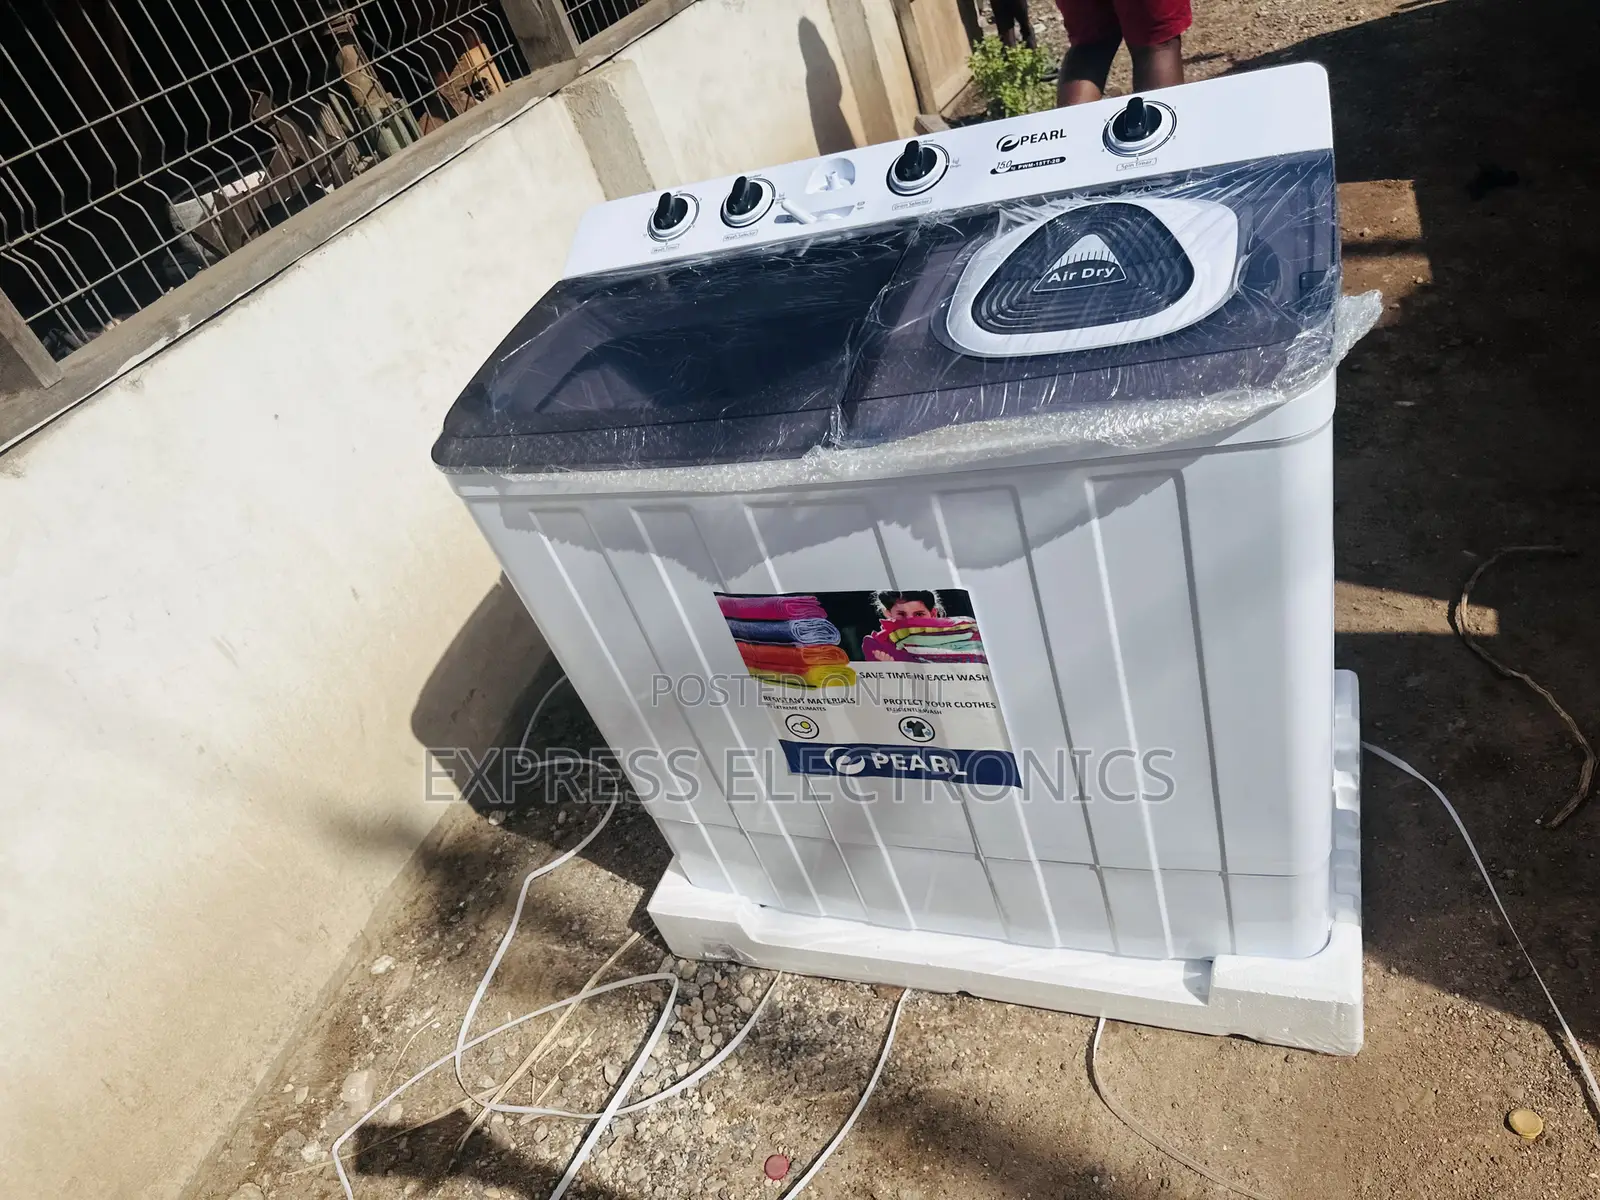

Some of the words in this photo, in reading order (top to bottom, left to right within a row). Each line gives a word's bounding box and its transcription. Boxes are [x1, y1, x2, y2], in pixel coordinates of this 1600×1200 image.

[1020, 128, 1067, 145] PEARL
[1047, 271, 1078, 283] Air
[1081, 267, 1116, 278] Dry
[859, 671, 885, 679] SAVE
[913, 672, 925, 681] IN
[956, 673, 990, 682] WASH
[763, 695, 806, 704] RESISTANT
[807, 697, 856, 705] MATERIALS
[883, 698, 924, 706] PROTECT
[924, 700, 952, 708] YOUR
[953, 701, 997, 709] CLOTHES
[870, 752, 968, 776] PEARL
